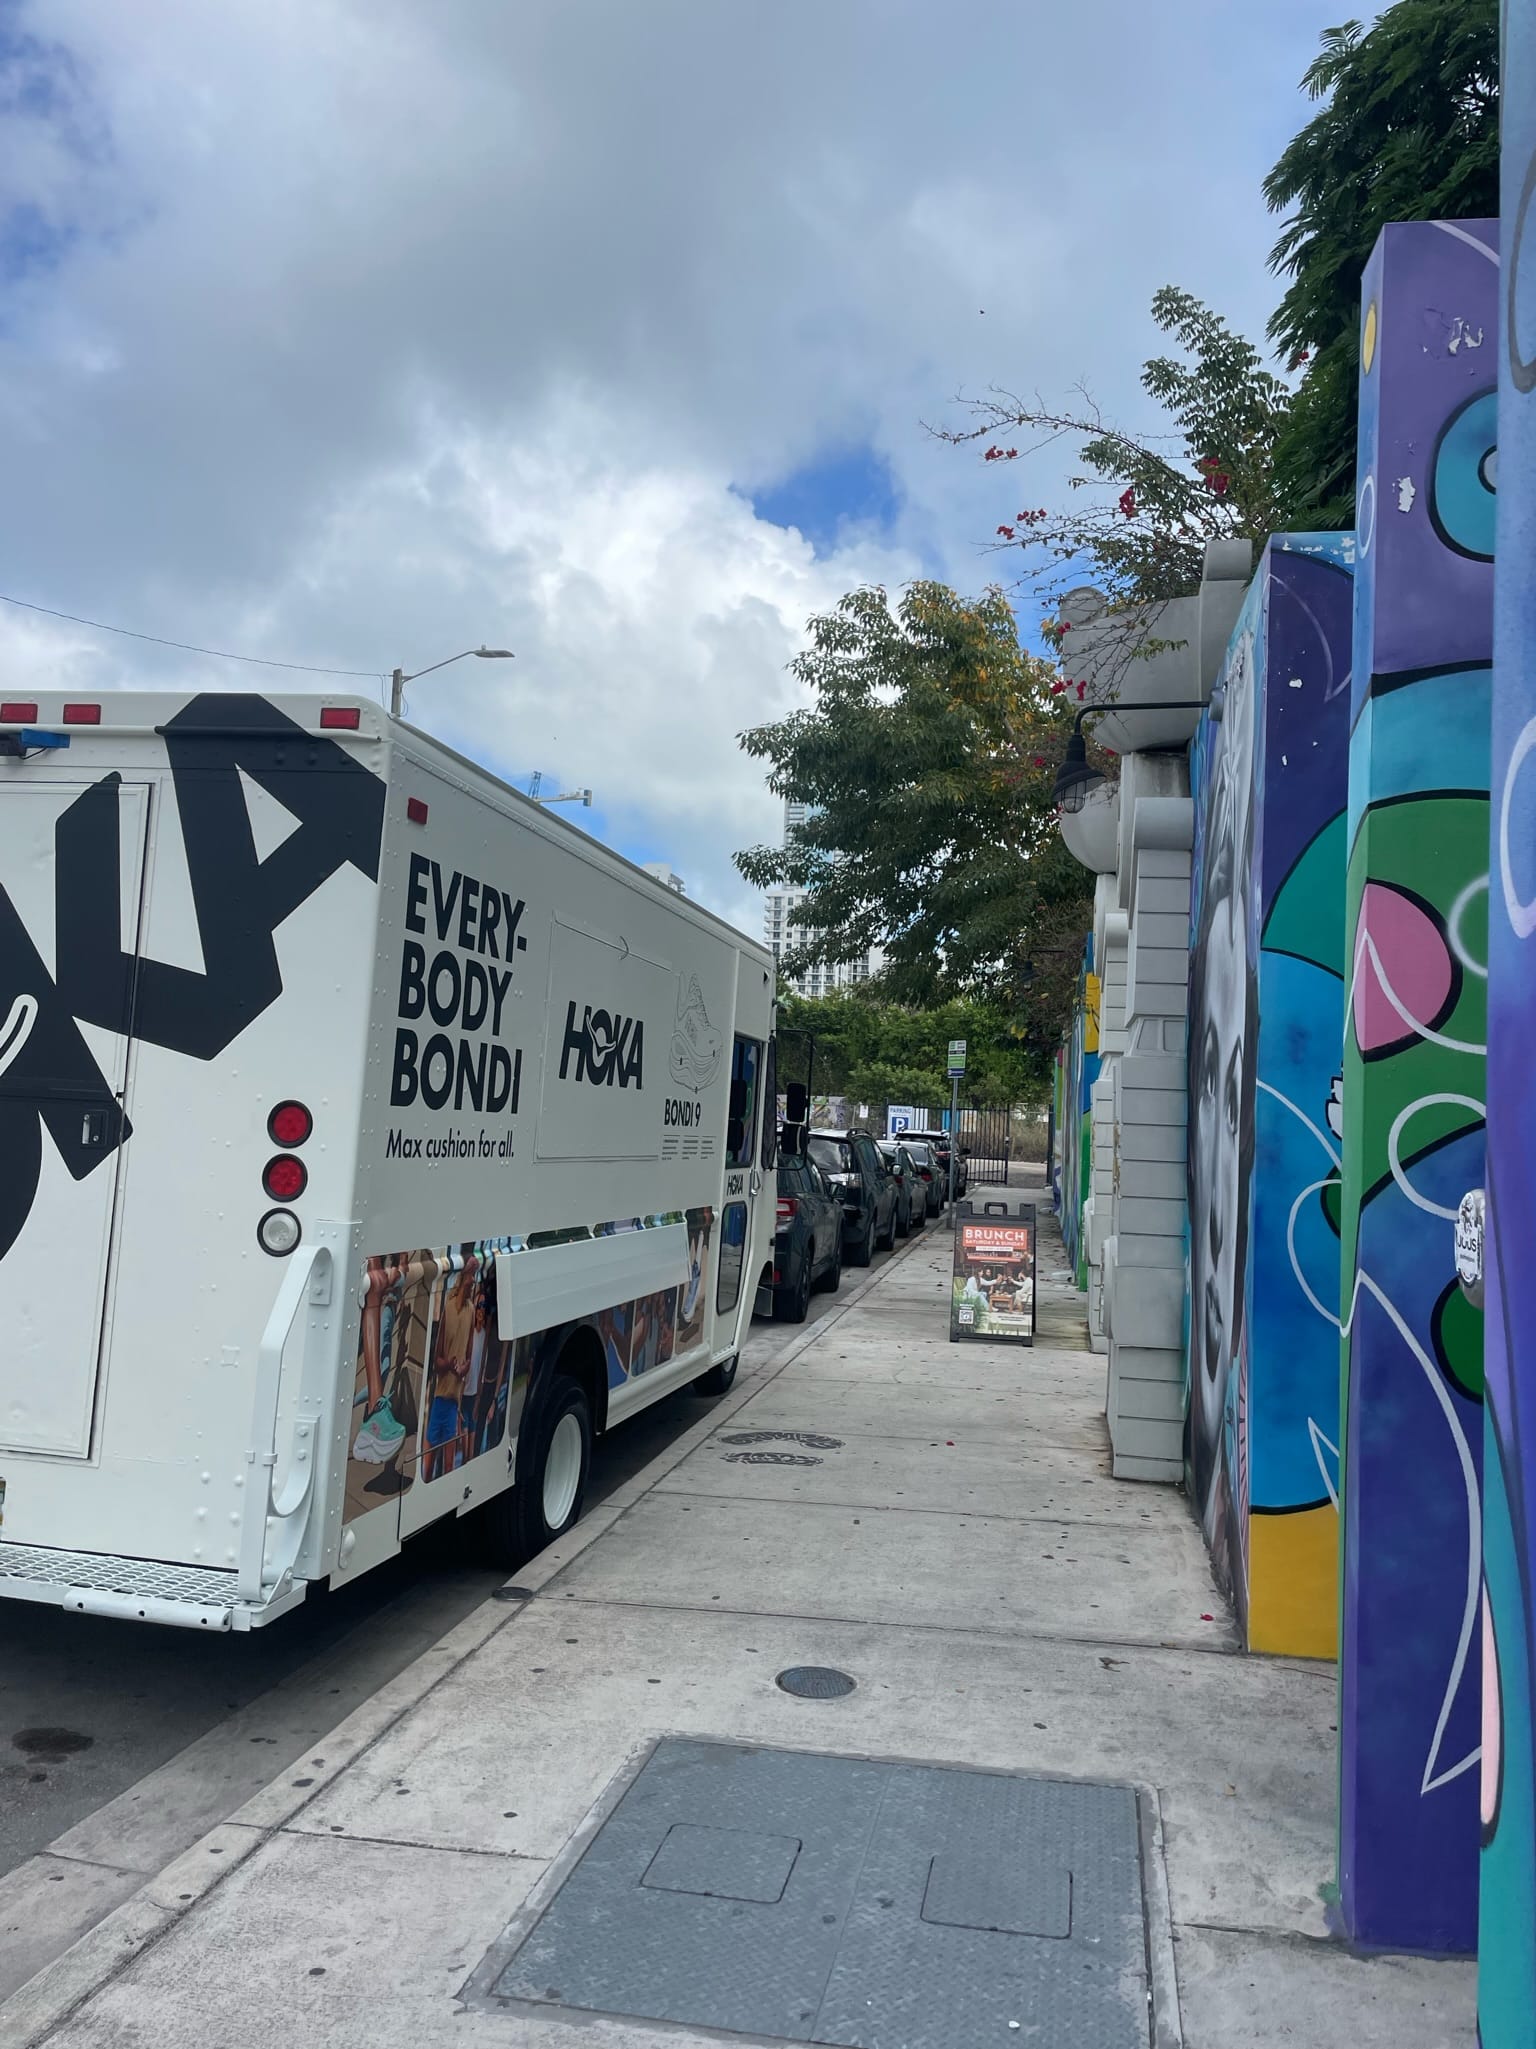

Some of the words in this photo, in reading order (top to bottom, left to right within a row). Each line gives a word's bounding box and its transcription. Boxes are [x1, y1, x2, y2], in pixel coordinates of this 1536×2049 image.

[405, 851, 528, 964] EVERY-
[398, 939, 513, 1036] BODY
[390, 1028, 522, 1114] BONDI
[559, 1000, 645, 1090] HOKA
[663, 1098, 694, 1127] BONDI
[695, 1102, 701, 1127] 9
[386, 1128, 422, 1158] Max
[426, 1127, 475, 1158] cushion
[478, 1128, 496, 1158] for
[498, 1130, 514, 1158] all.
[726, 1174, 744, 1196] HOKA
[965, 1229, 1024, 1241] BRUNCH
